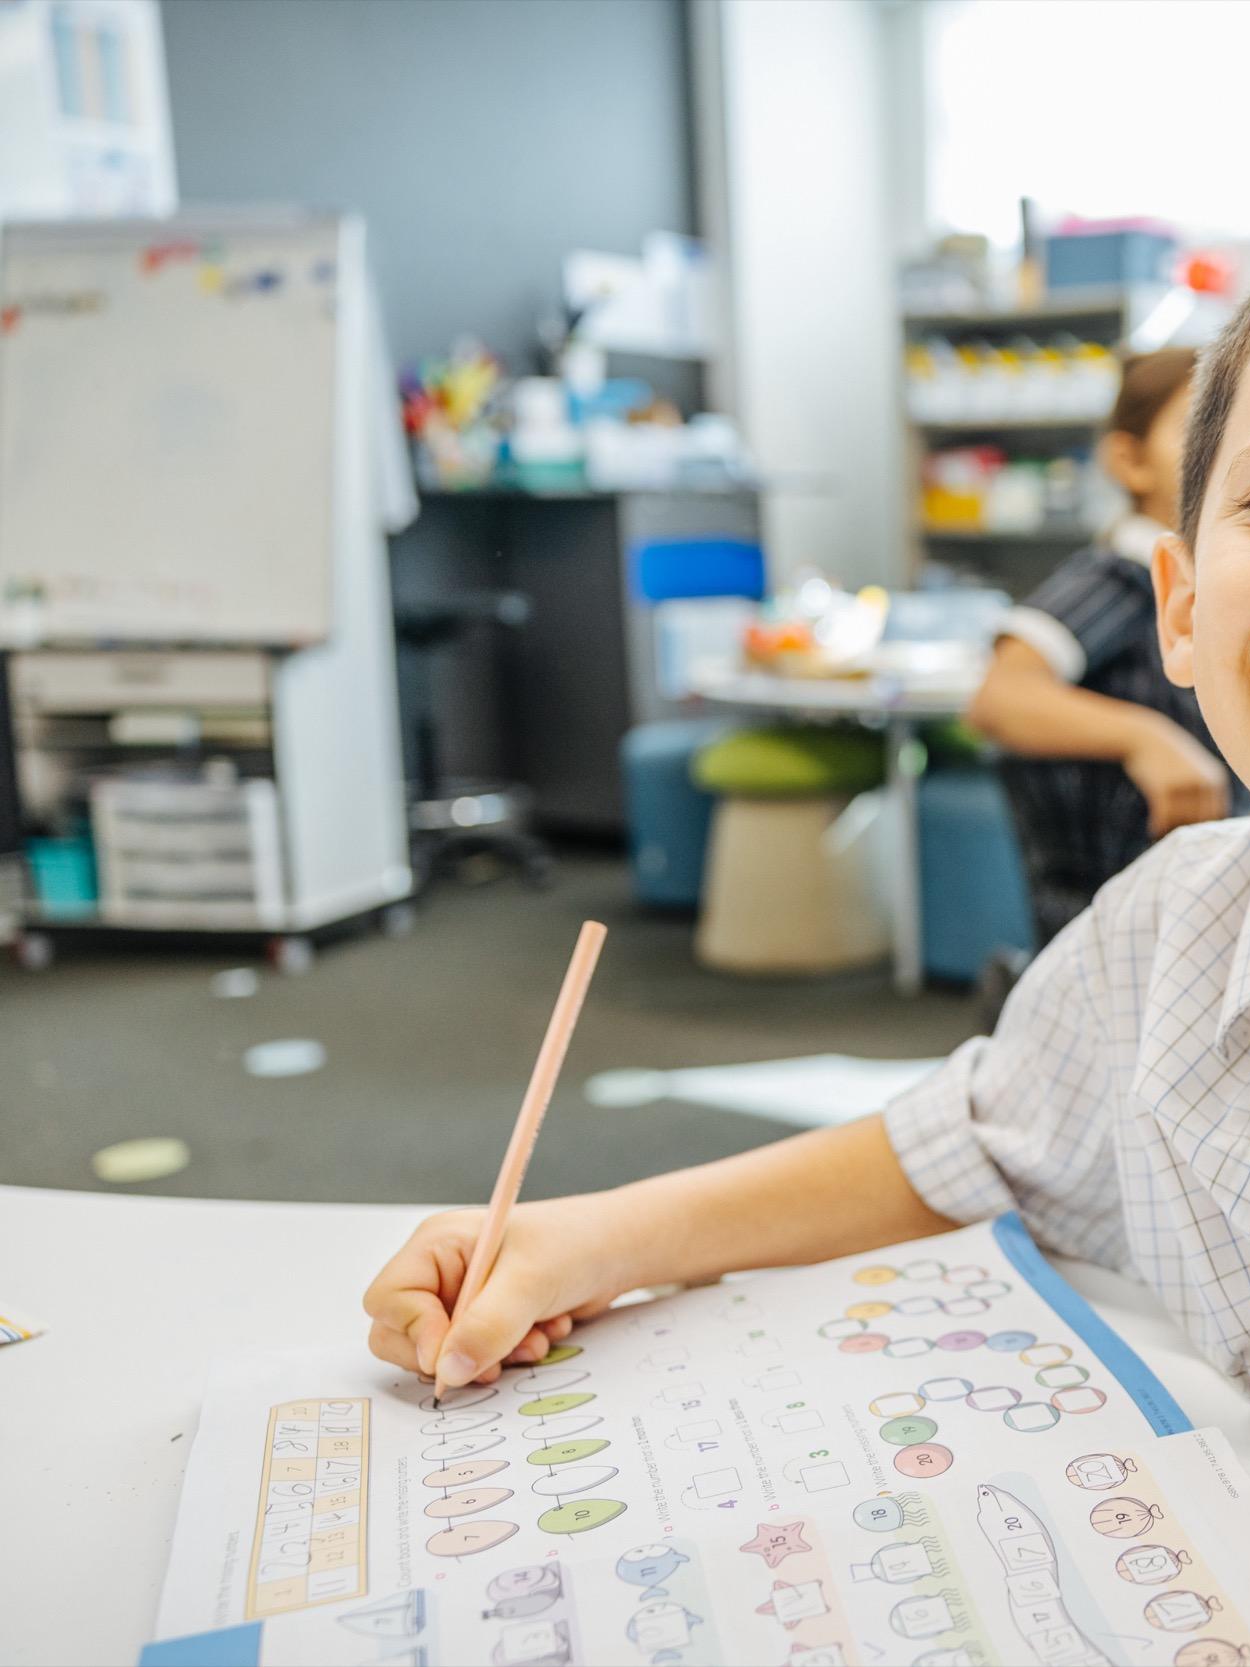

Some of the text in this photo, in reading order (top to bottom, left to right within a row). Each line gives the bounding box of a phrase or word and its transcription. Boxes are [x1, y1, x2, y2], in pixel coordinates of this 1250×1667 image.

[901, 1425, 916, 1435] 19
[273, 1440, 308, 1452] 8
[333, 1441, 349, 1451] 18
[697, 1442, 719, 1453] 17
[808, 1449, 830, 1459] 3
[865, 1453, 878, 1465] the
[915, 1453, 933, 1466] 20
[755, 1466, 769, 1479] the
[872, 1466, 888, 1488] Write
[1076, 1460, 1113, 1483] 20
[271, 1483, 312, 1497] 6
[652, 1489, 665, 1501] the
[759, 1479, 776, 1502] Write
[716, 1499, 738, 1509] 4
[575, 1510, 591, 1520] 10
[655, 1502, 671, 1524] Write
[871, 1508, 888, 1520] 18
[1115, 1513, 1132, 1525] 19
[1003, 1517, 1023, 1531] 20
[770, 1535, 786, 1549] 15
[640, 1566, 657, 1578] 11
[1156, 1602, 1203, 1624] 17
